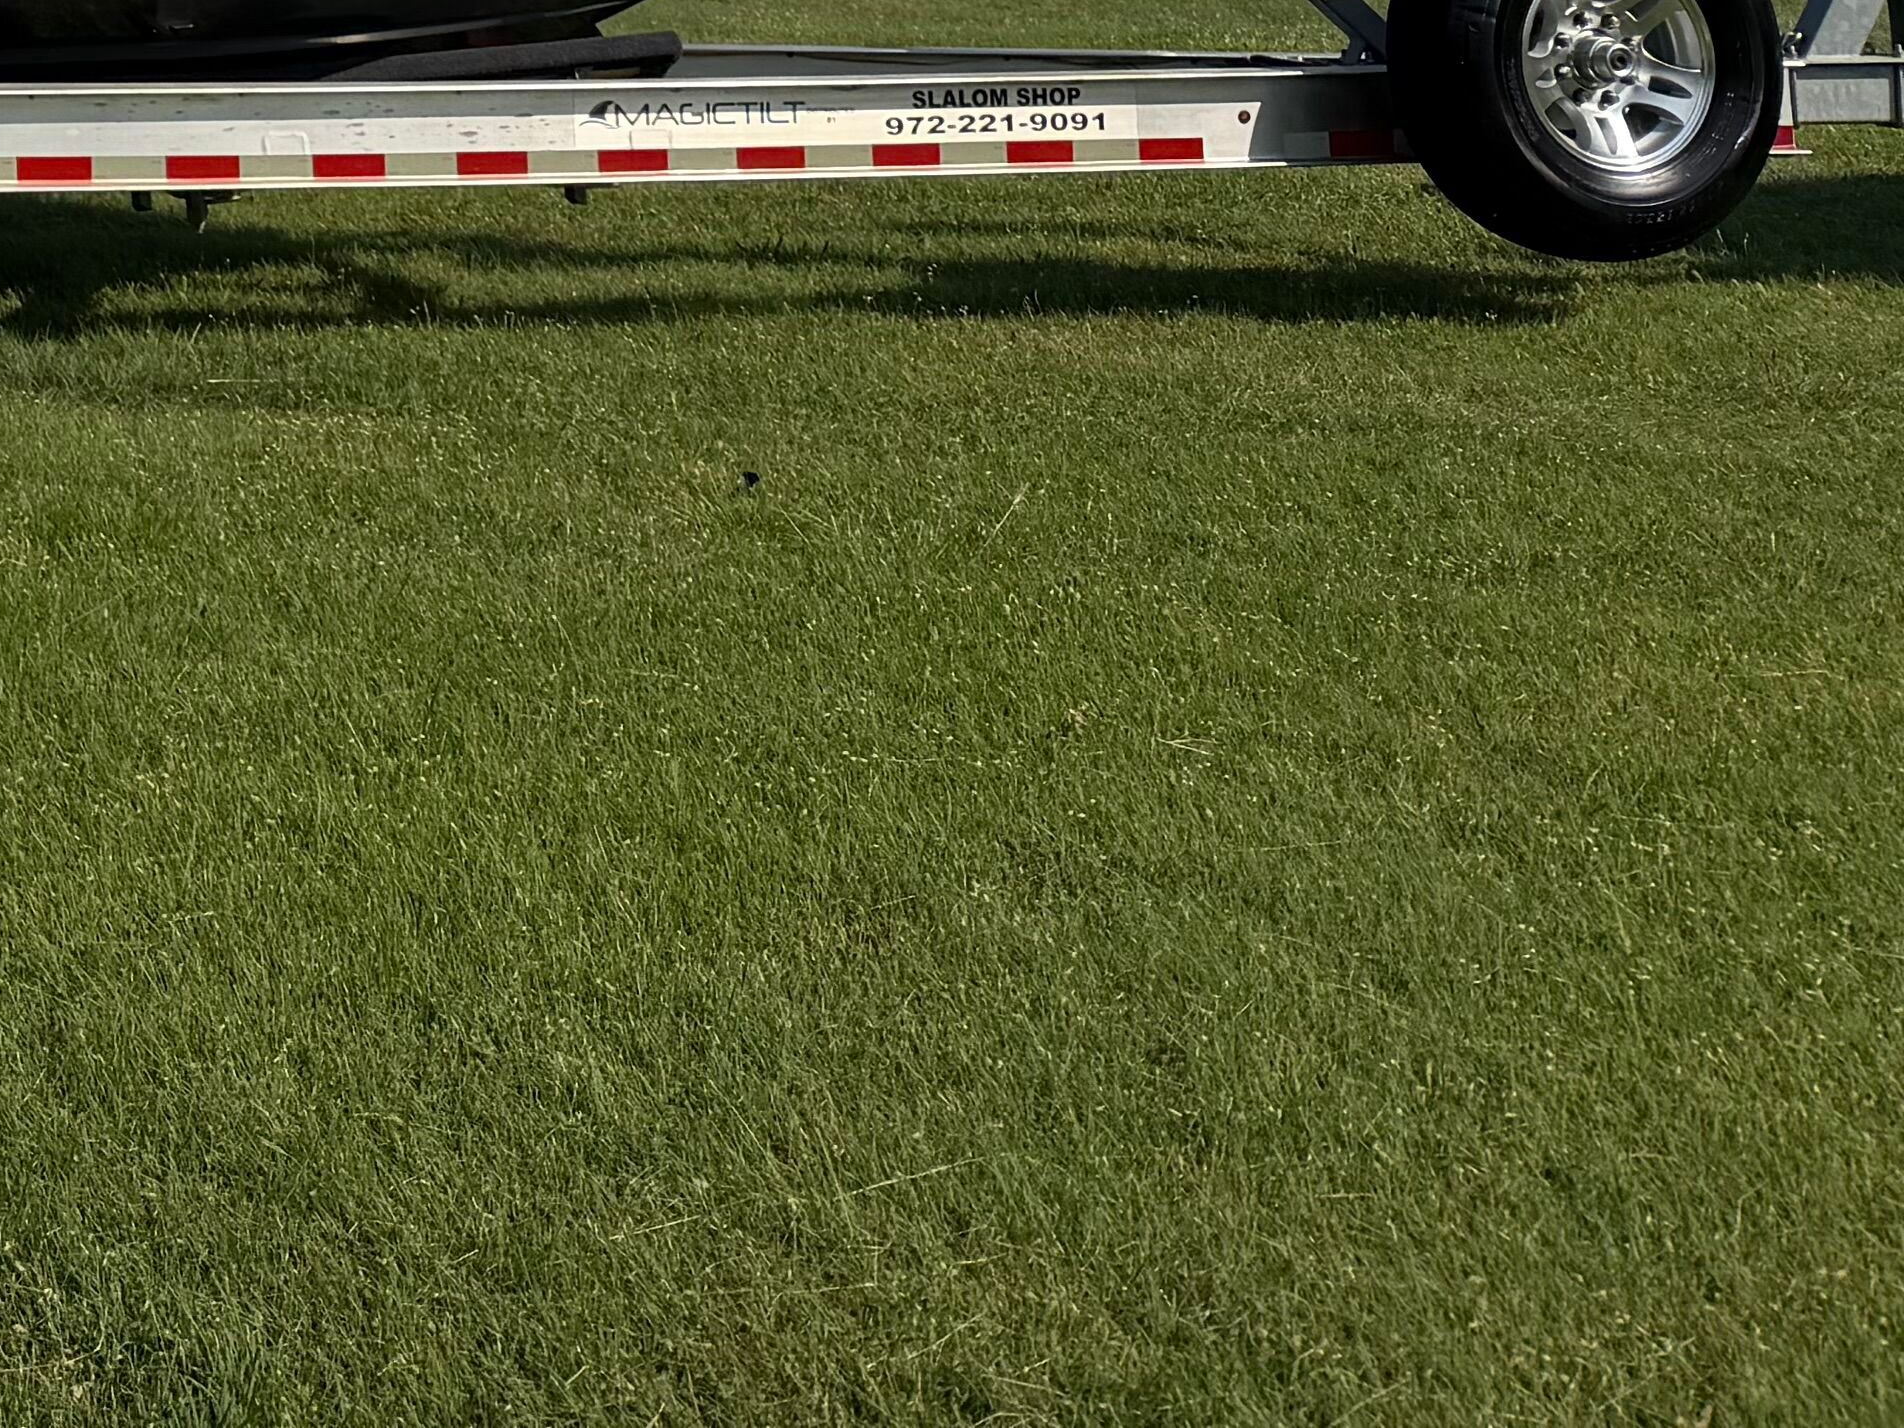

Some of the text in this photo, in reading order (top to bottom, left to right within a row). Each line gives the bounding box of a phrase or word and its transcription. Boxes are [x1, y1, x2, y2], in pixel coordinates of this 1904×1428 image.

[911, 87, 1081, 109] SLALOM SHOP
[613, 100, 806, 127] MAGICTILT
[885, 112, 1106, 136] 972-221-9091
